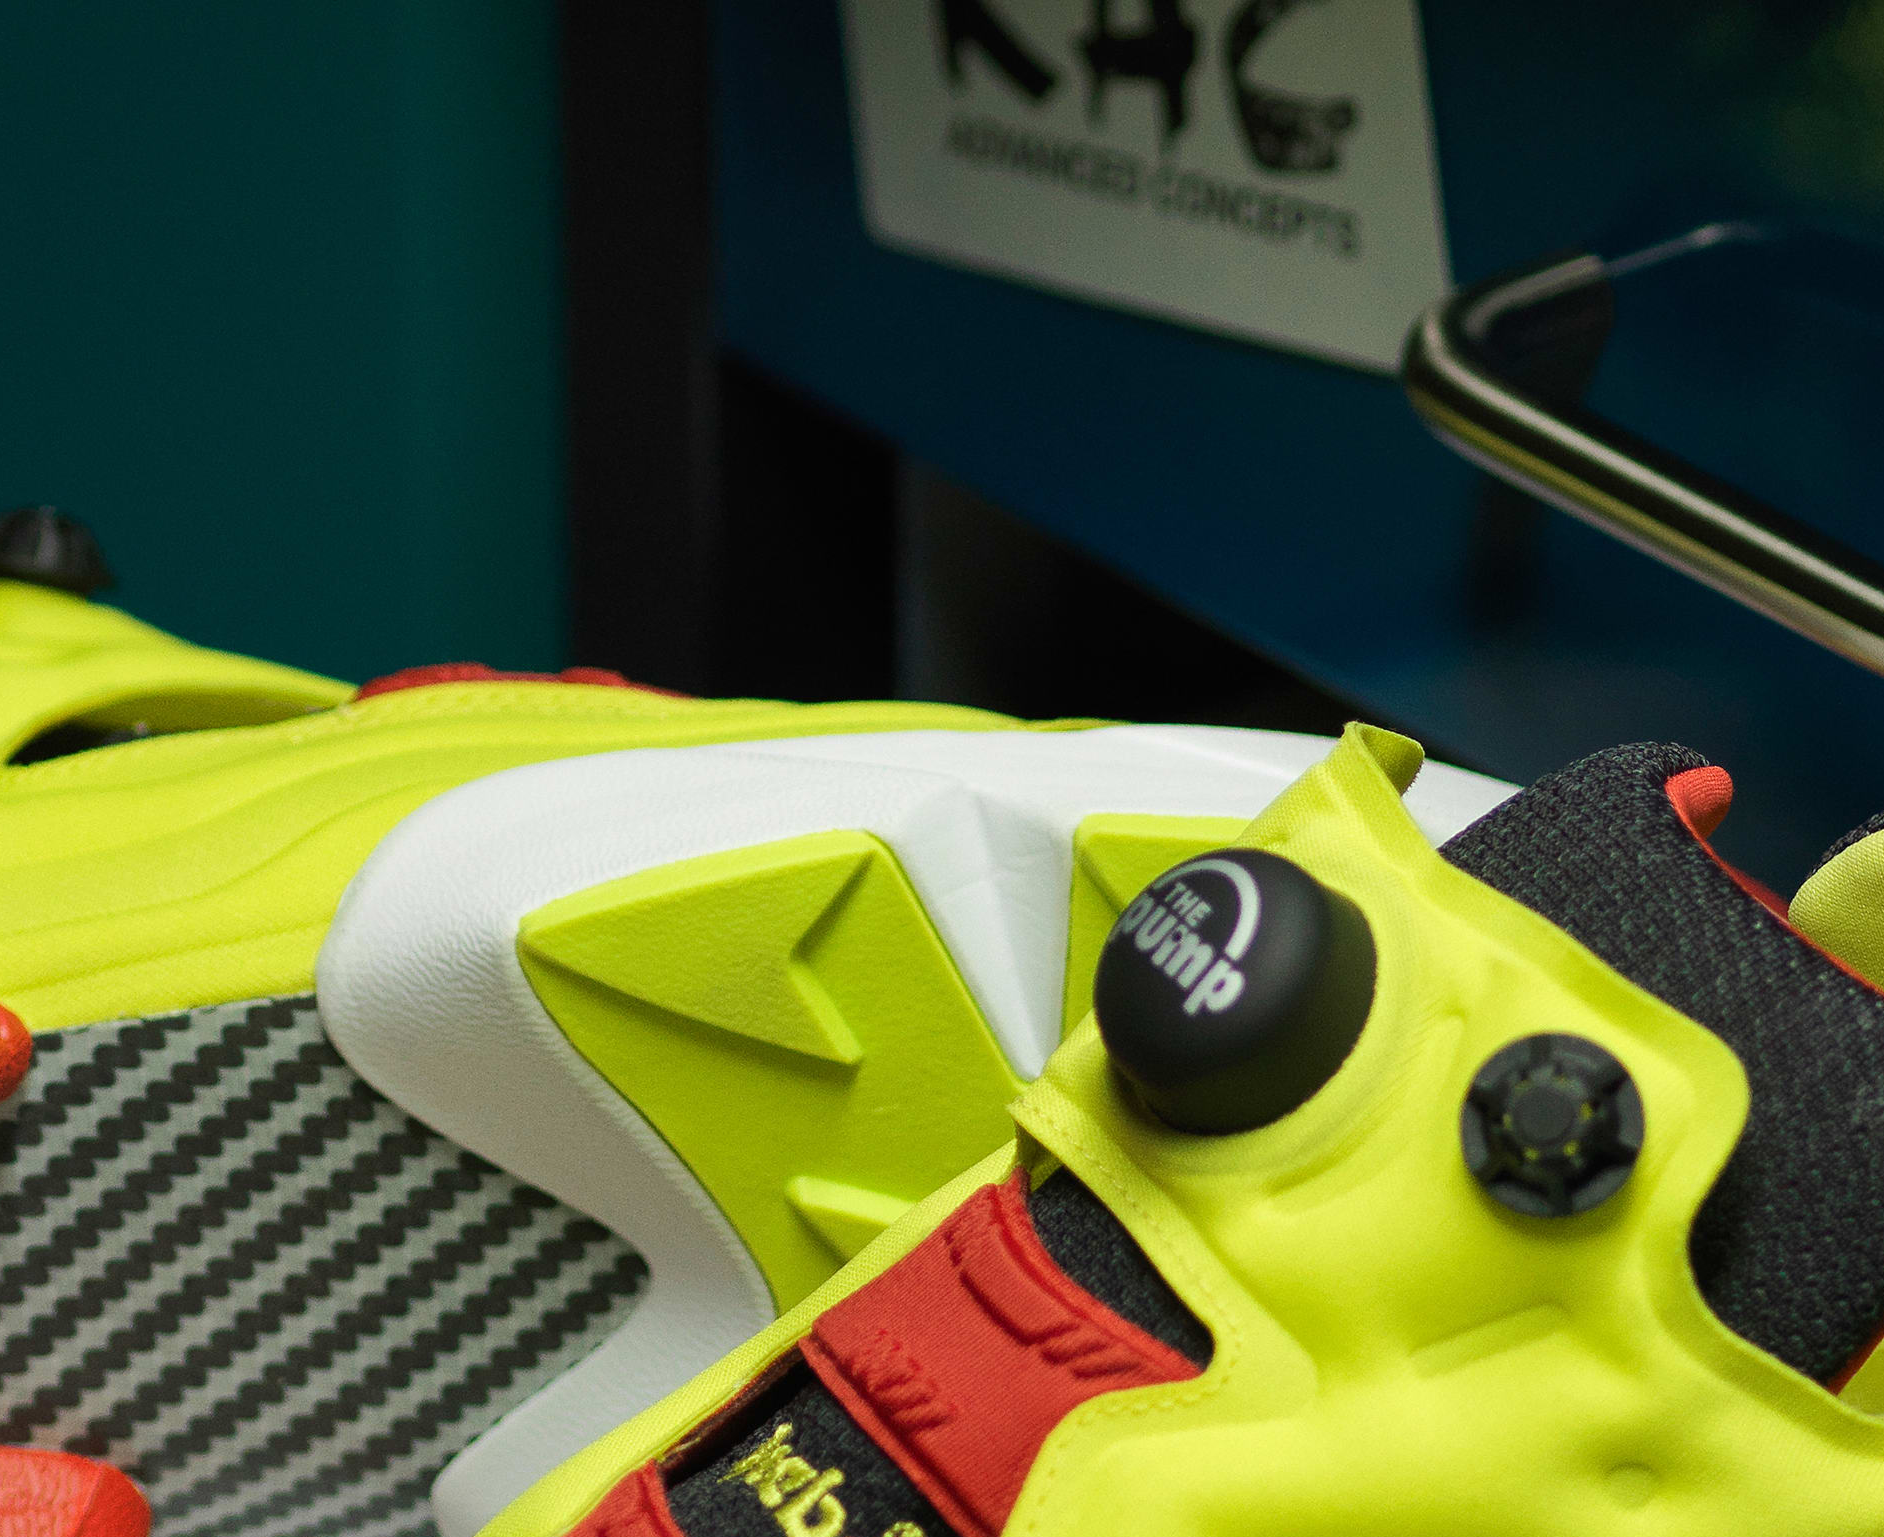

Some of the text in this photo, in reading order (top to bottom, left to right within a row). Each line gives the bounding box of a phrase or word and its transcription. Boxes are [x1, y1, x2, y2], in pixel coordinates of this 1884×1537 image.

[946, 113, 1362, 260] ADVANCED CONCEPTS
[1164, 881, 1213, 928] THE
